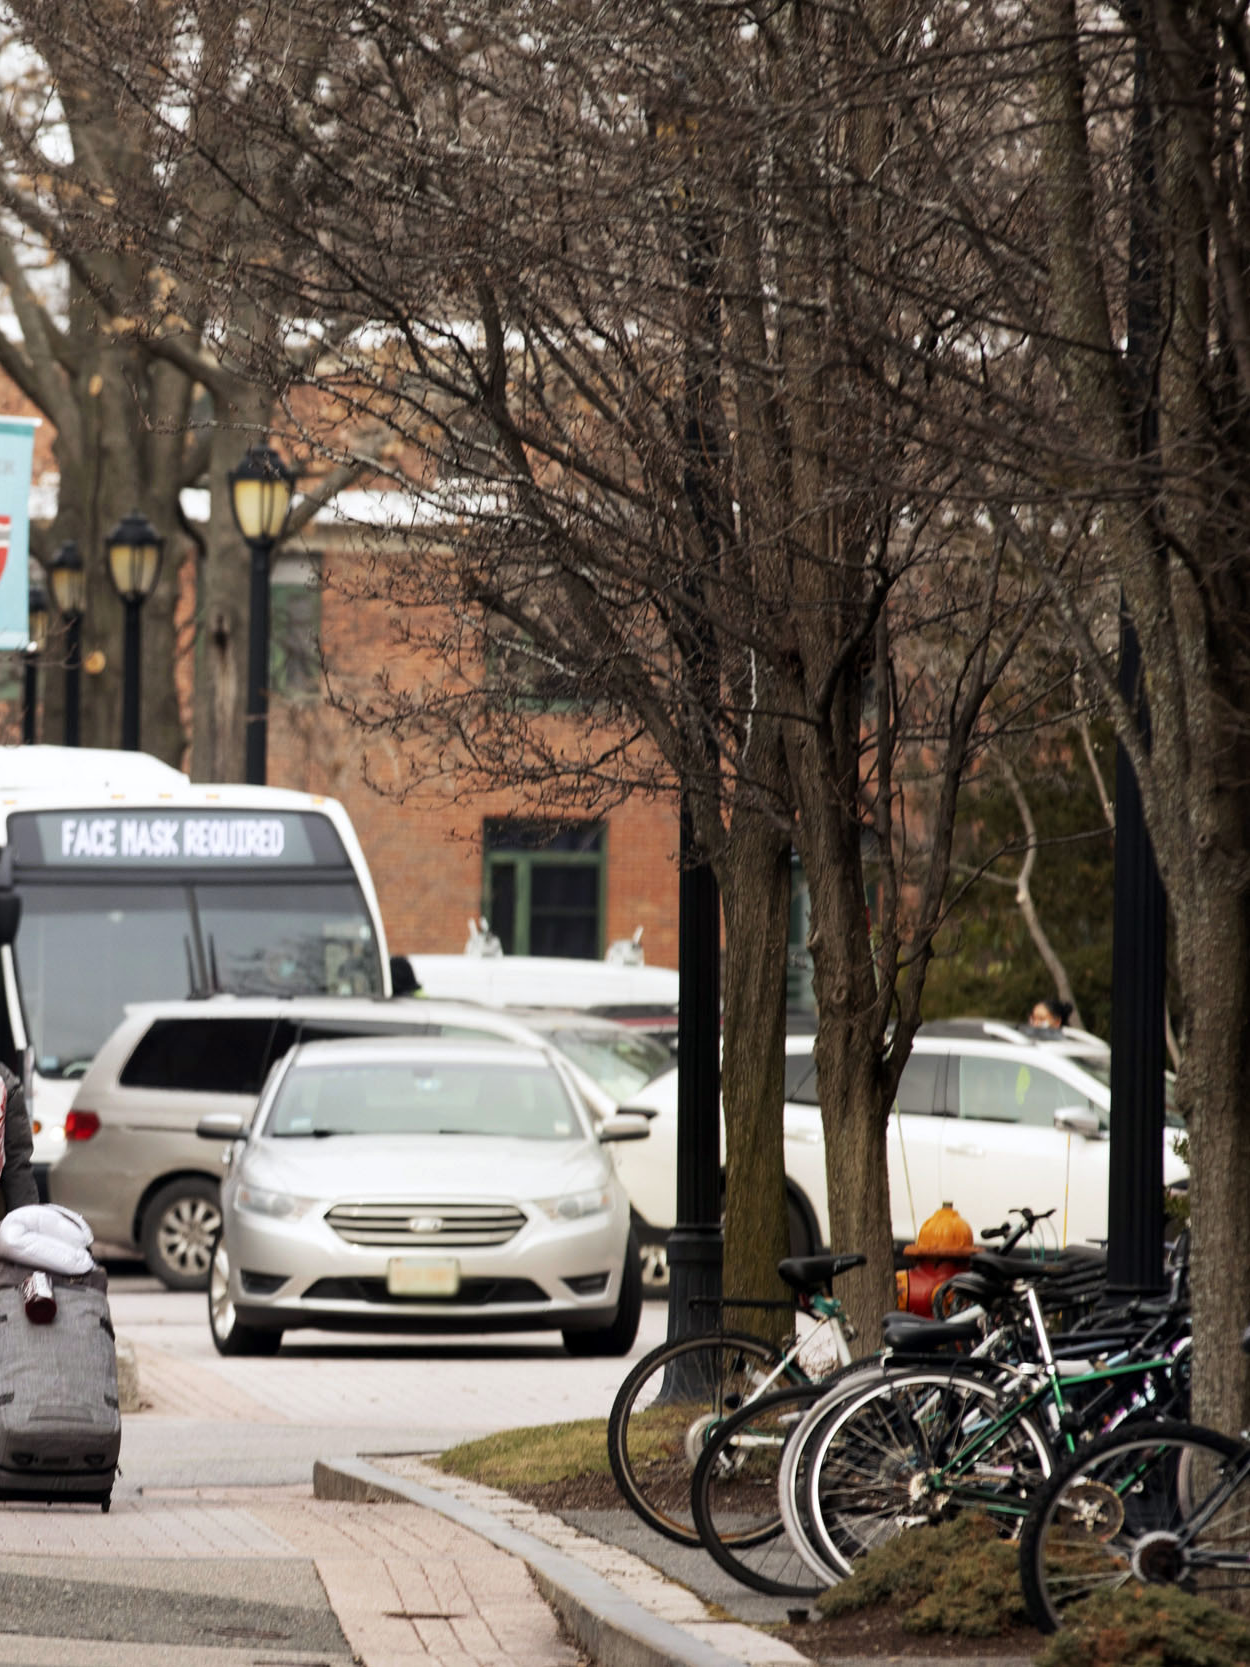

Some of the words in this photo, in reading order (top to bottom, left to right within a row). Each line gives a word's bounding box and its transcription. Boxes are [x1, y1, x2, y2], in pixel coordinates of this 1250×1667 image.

[61, 819, 117, 857] FACE
[121, 819, 179, 857] MASK
[183, 819, 285, 857] REQUIRED
